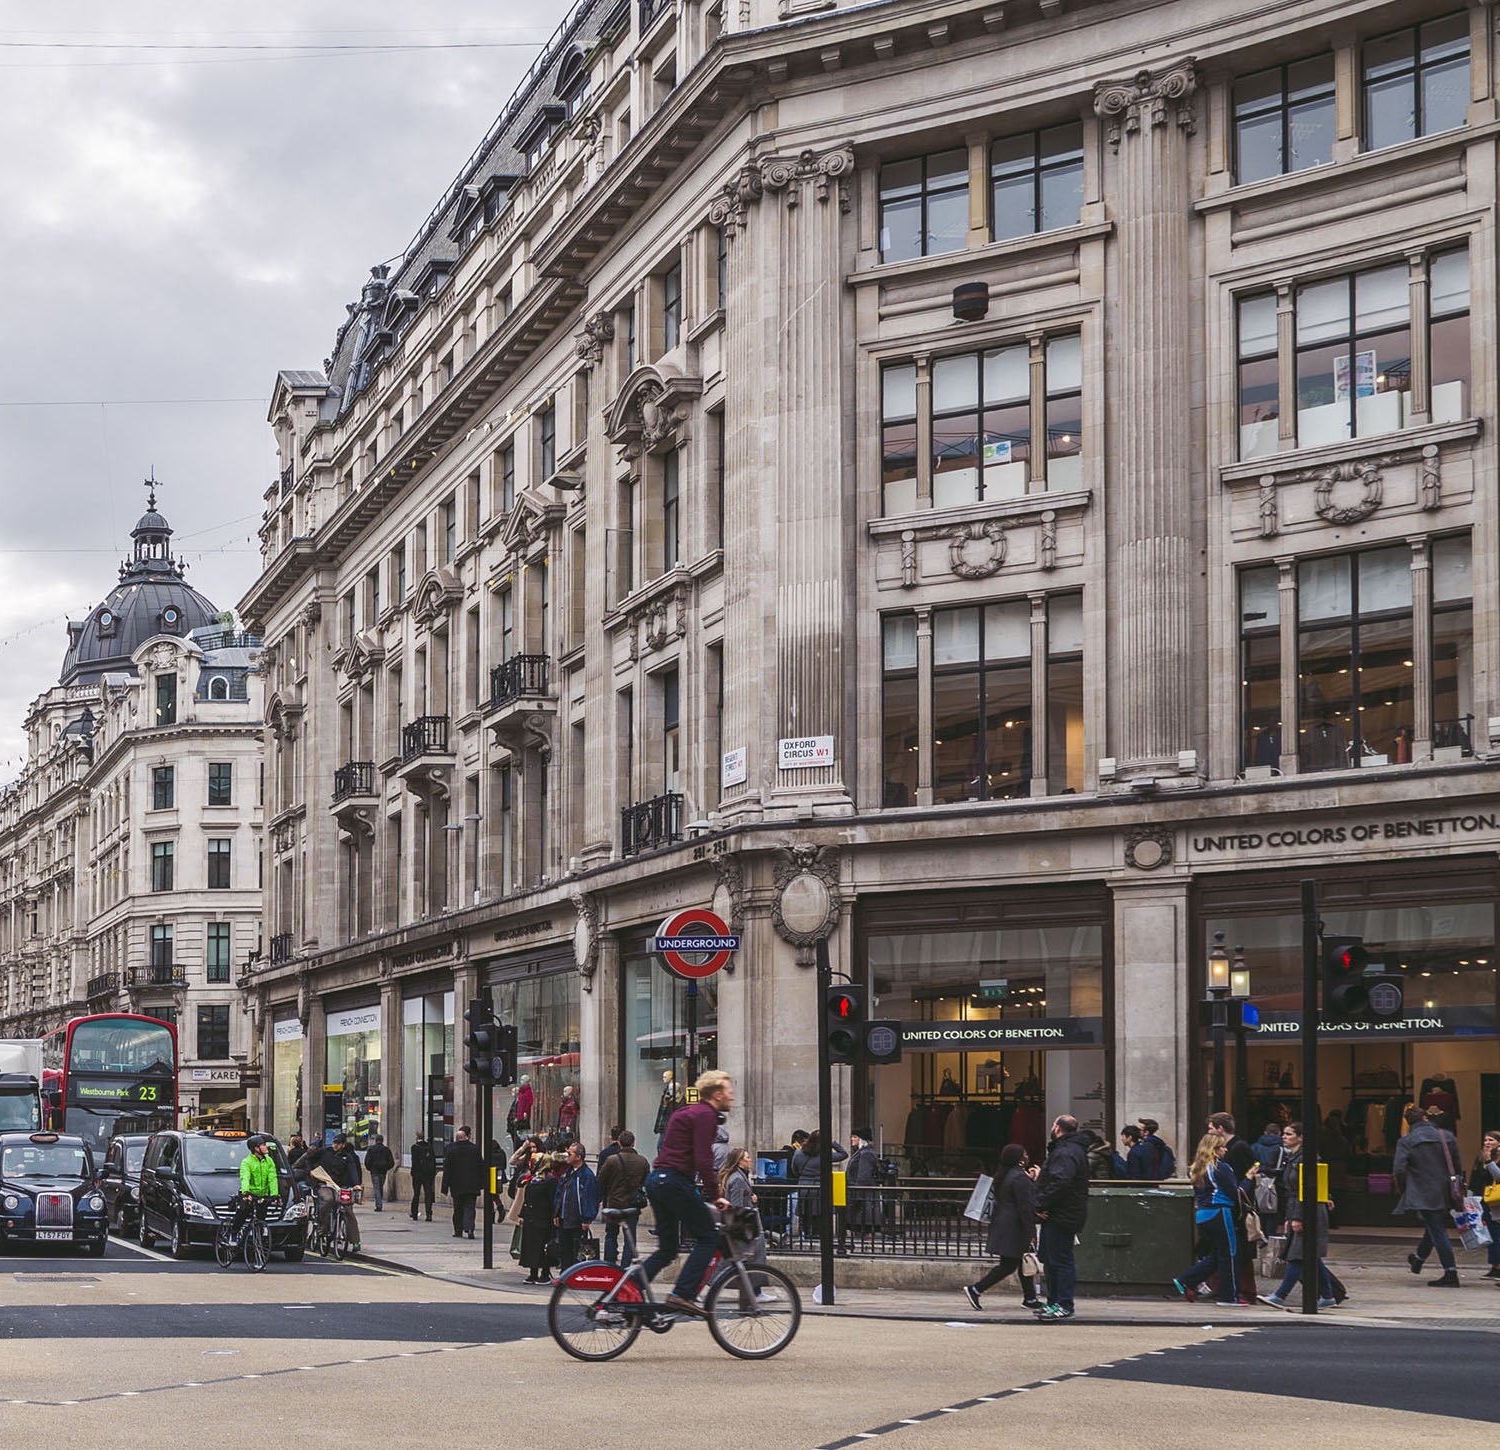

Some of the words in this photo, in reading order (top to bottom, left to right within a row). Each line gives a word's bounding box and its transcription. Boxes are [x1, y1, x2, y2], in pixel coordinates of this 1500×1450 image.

[784, 740, 816, 749] OXFORD
[784, 749, 814, 758] CIRCUS
[816, 748, 829, 756] W1
[1193, 833, 1263, 853] UNITED
[1266, 826, 1347, 847] COLORS
[1351, 824, 1380, 842] OF
[1384, 813, 1500, 839] BENETTON.
[659, 939, 736, 948] UNDERGROUND
[1316, 1021, 1351, 1031] LORS
[902, 1031, 941, 1041] UNITED
[943, 1030, 986, 1040] COLORS
[988, 1030, 1003, 1039] OF
[1005, 1028, 1064, 1038] BENETTON.
[211, 1071, 241, 1080] KAREN
[80, 1087, 115, 1096] Westbourne
[116, 1088, 130, 1097] Park
[139, 1086, 157, 1101] 23
